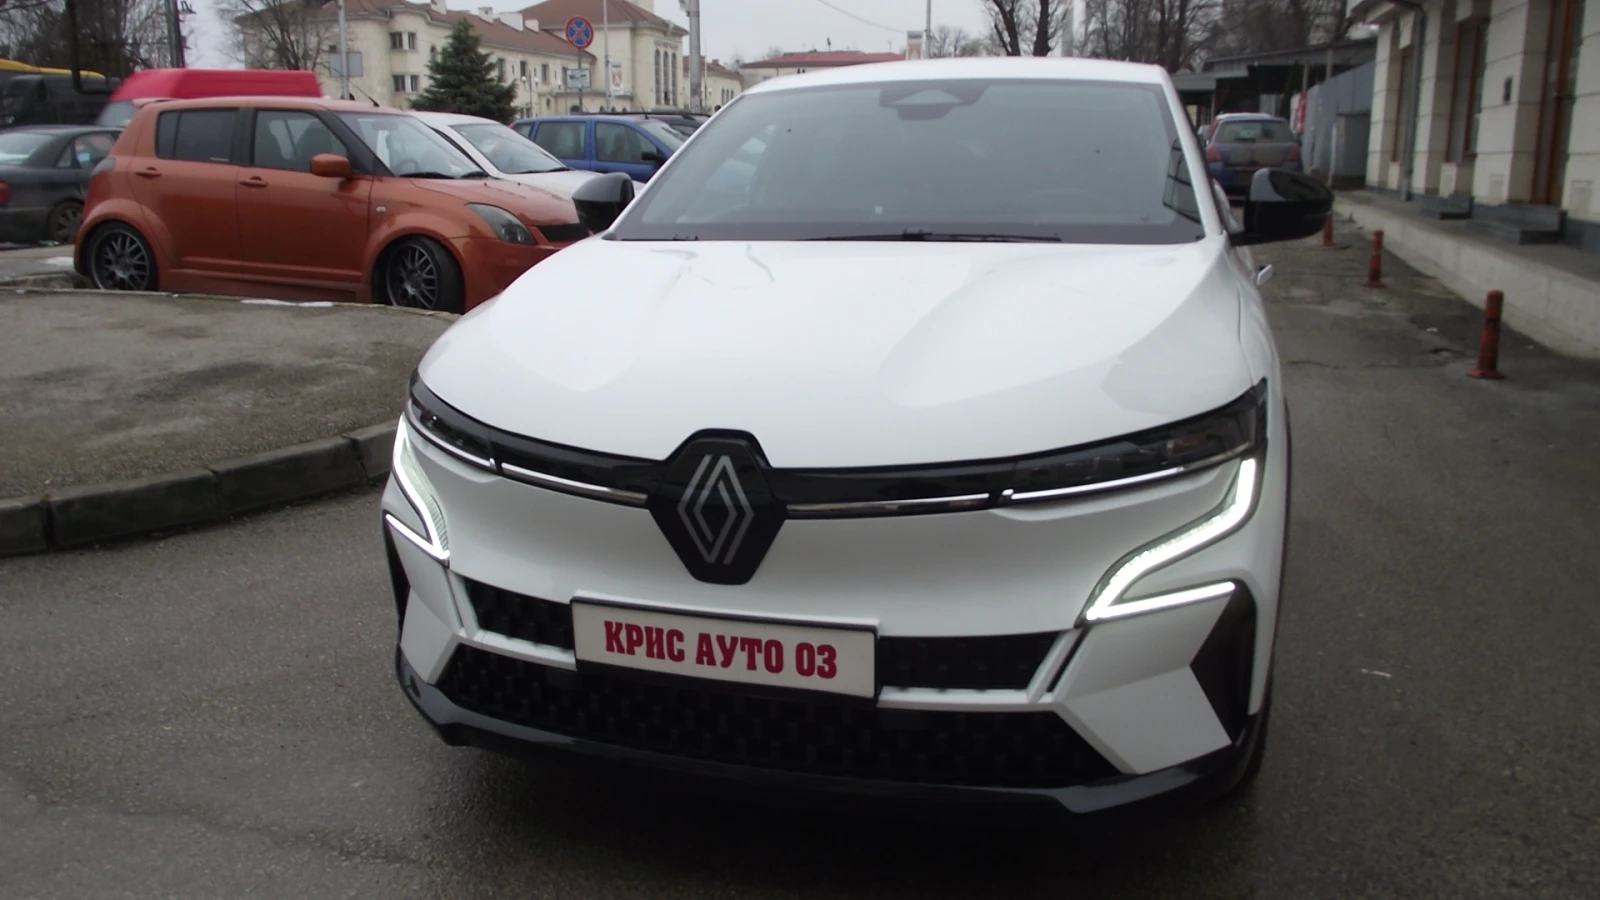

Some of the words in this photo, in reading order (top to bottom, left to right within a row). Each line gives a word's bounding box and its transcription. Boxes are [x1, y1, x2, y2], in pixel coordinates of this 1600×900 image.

[604, 620, 685, 662] КРИС
[695, 632, 784, 674] АУТО
[795, 642, 837, 679] 03
